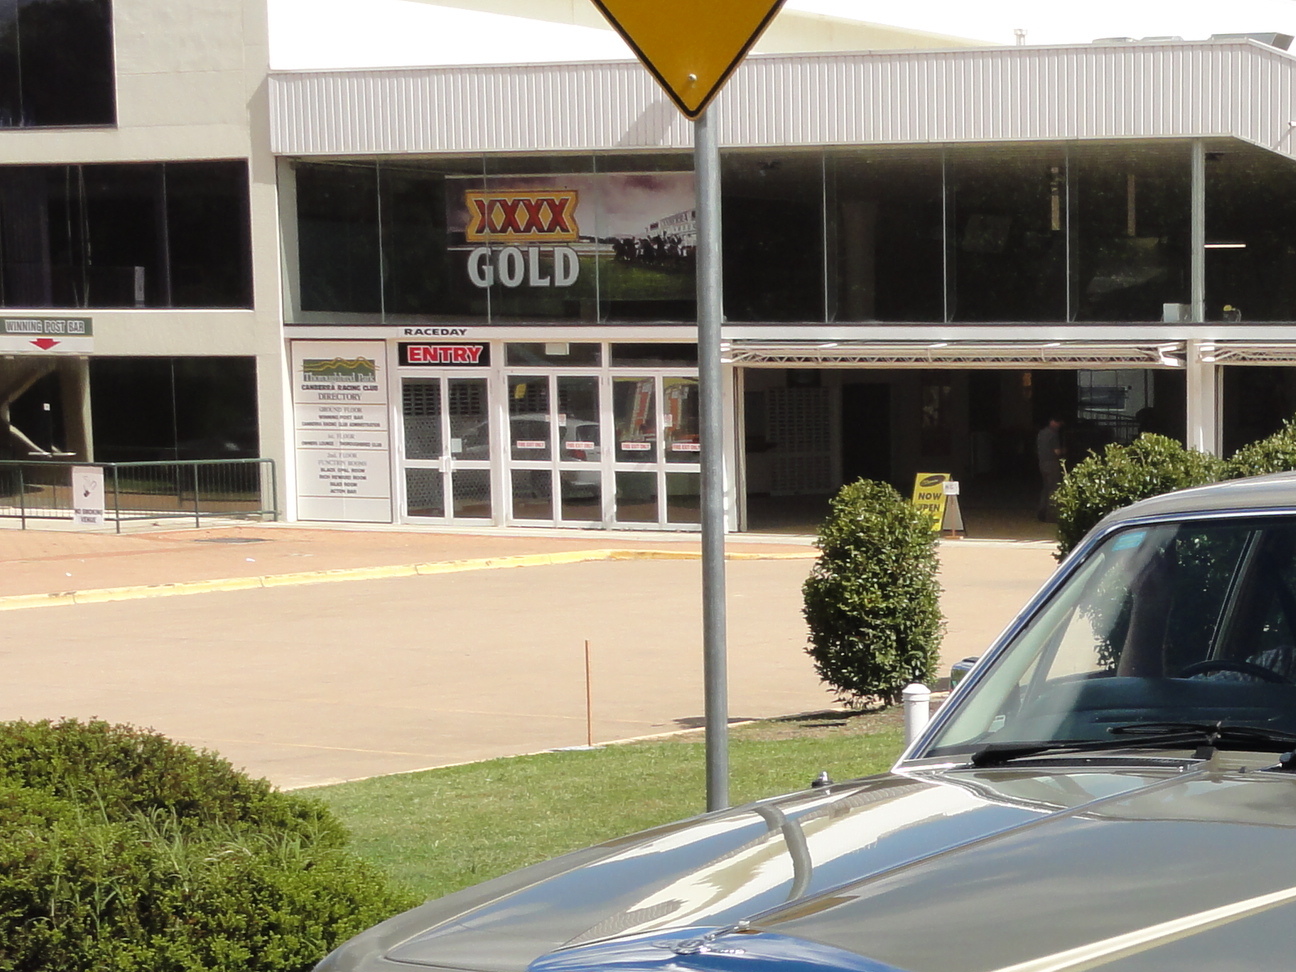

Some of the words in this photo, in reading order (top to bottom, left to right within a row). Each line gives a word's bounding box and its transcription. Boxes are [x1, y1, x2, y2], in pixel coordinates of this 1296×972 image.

[472, 197, 573, 236] XXXX
[467, 246, 580, 288] GOLD
[5, 320, 42, 333] WINNING
[44, 320, 66, 333] POST
[67, 321, 85, 333] BAR
[407, 345, 483, 363] ENTRY
[304, 372, 356, 384] Thoroughbred
[358, 372, 375, 382] Park
[318, 392, 362, 400] DIRECTORY
[918, 492, 942, 500] NOW
